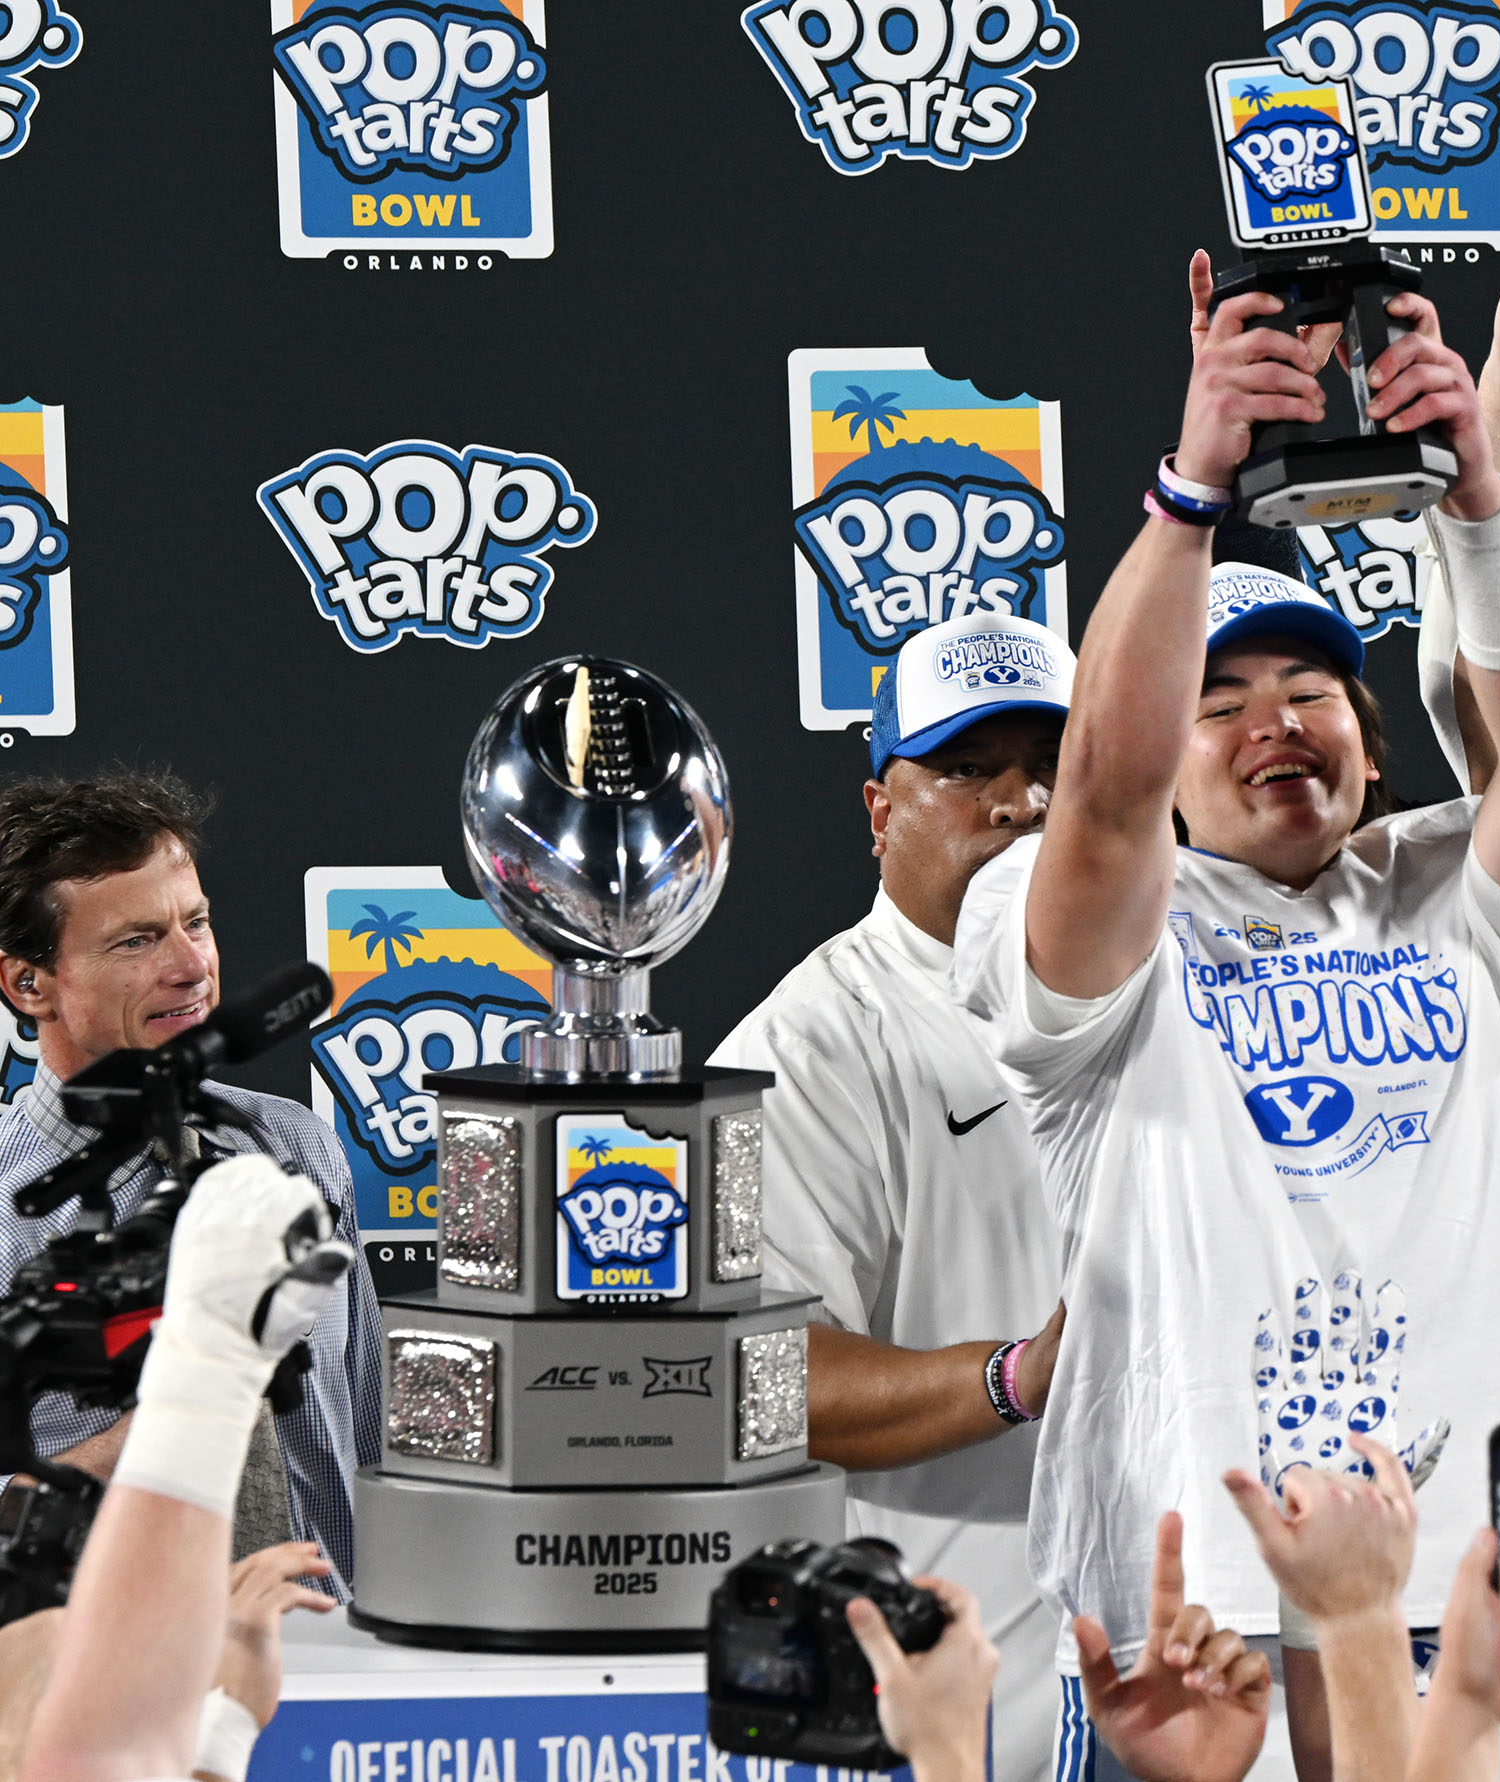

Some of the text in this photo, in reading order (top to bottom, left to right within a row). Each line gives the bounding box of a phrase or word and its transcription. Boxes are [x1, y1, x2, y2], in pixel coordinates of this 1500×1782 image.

[331, 100, 499, 164] tarts
[814, 78, 1020, 160] tarts
[1356, 93, 1490, 154] arts
[1258, 161, 1336, 196] tarts
[351, 194, 480, 227] BOWL
[1270, 203, 1333, 223] BOWL
[1372, 187, 1468, 219] OWL
[1270, 228, 1342, 243] ORLANDO
[343, 256, 493, 270] ORLANDO
[1307, 255, 1330, 265] MVP
[329, 554, 538, 638] tarts
[1207, 580, 1301, 609] AMPIONS
[940, 633, 1045, 650] THE PEOPLE'S NATIONAL
[936, 641, 1058, 680] CHAMPIONS
[1288, 931, 1318, 945] 25
[1304, 943, 1430, 976] NATIONAL
[1377, 1079, 1428, 1094] ORLANDO FL
[1274, 1130, 1379, 1177] YOUNG UNIVERSITY
[388, 1185, 438, 1218] BO
[583, 1227, 665, 1259] tarts
[591, 1268, 653, 1286] BOWL
[586, 1293, 660, 1304] ORLANDO
[530, 1366, 600, 1387] ACC
[608, 1370, 633, 1386] VS.
[567, 1435, 674, 1449] ORLANDO, FLORIDA
[515, 1531, 732, 1567] CHAMPIONS
[594, 1571, 659, 1596] 2025
[330, 1738, 517, 1782] OFFICIAL
